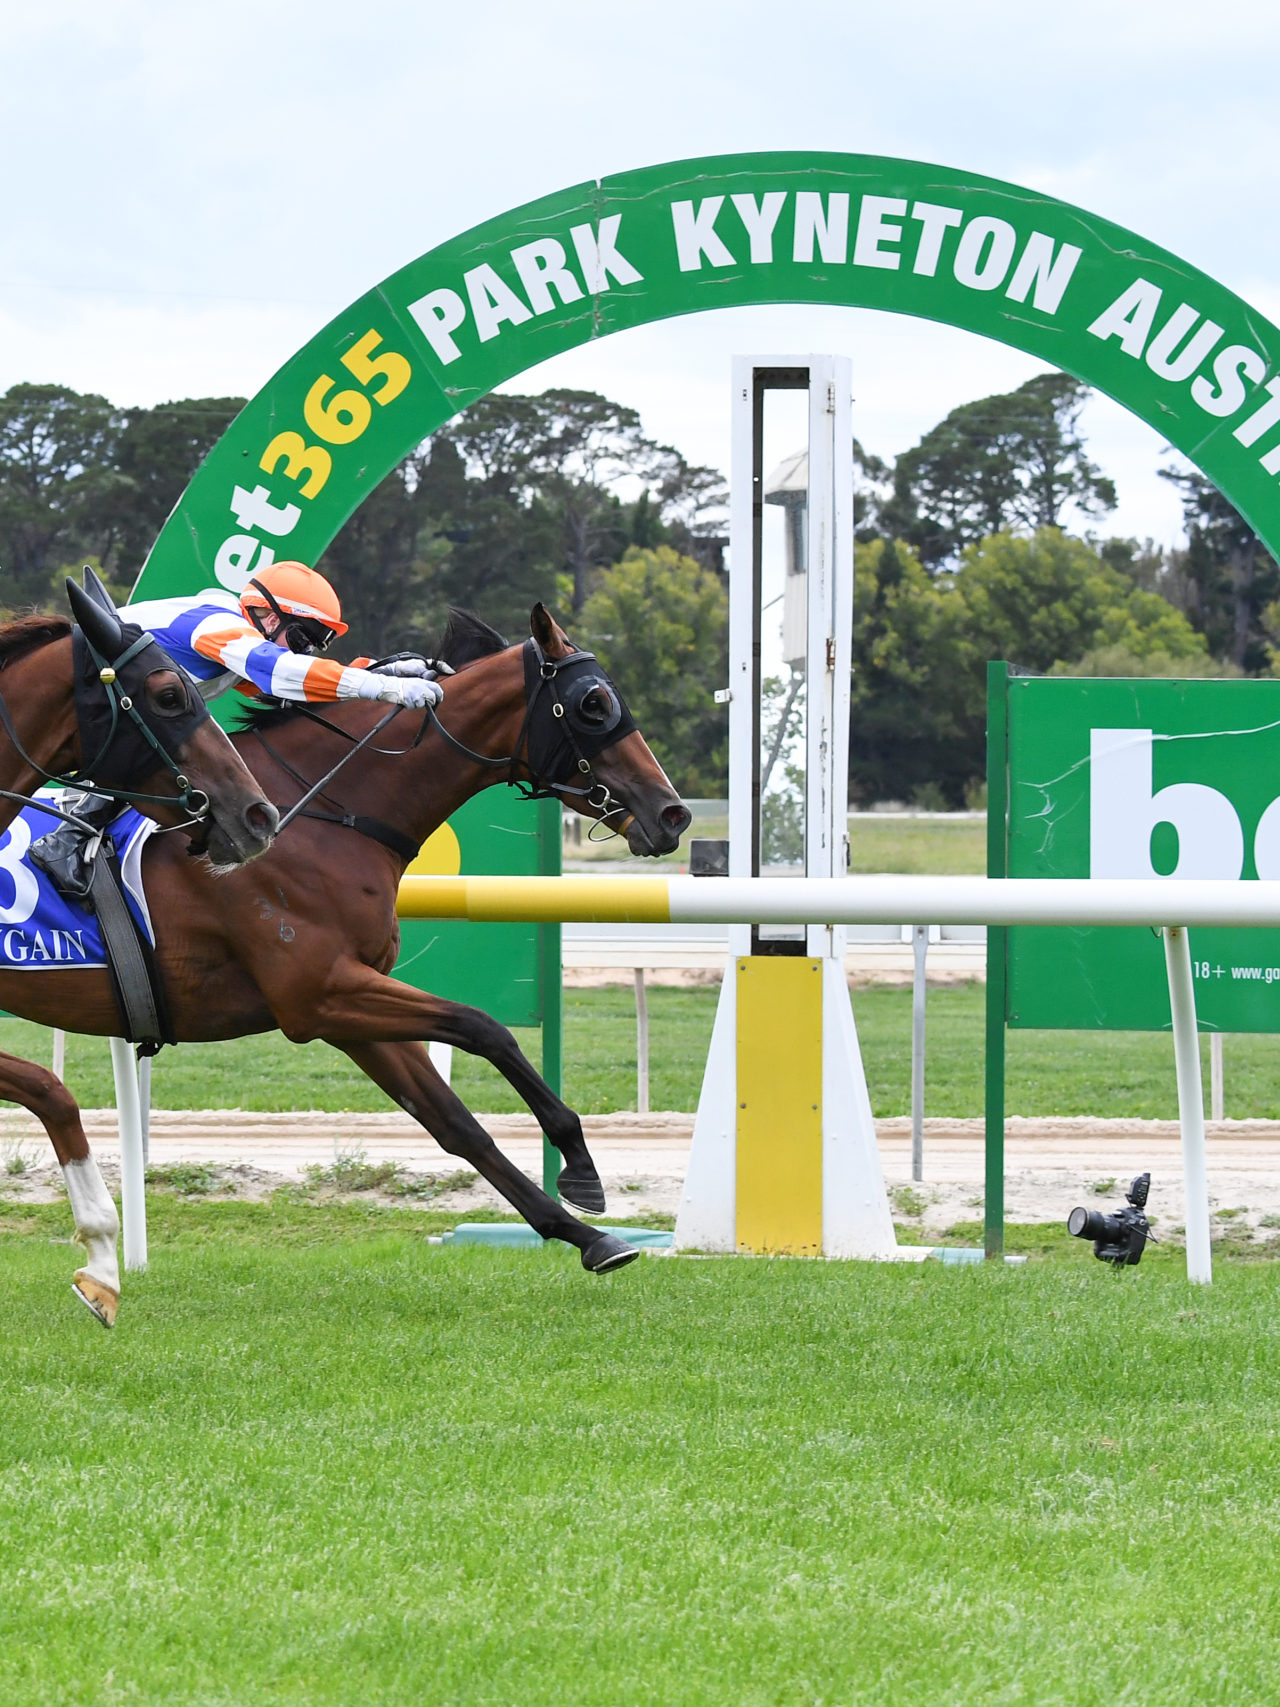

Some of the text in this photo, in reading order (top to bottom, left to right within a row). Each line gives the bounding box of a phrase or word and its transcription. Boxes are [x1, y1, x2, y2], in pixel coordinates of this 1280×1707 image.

[197, 191, 1280, 598] et365 PARK KYNETON AUST
[1193, 961, 1227, 979] 18+
